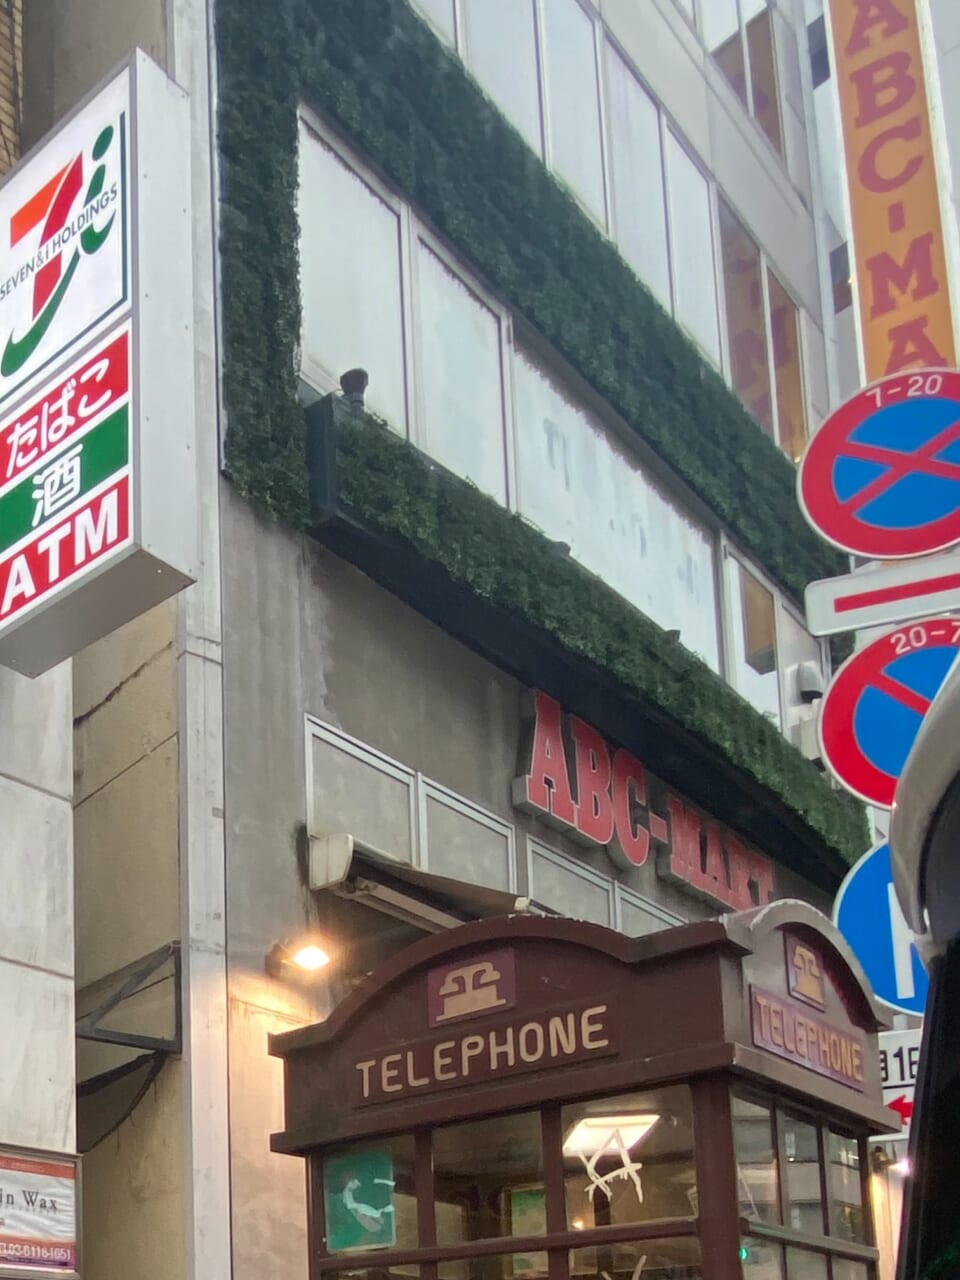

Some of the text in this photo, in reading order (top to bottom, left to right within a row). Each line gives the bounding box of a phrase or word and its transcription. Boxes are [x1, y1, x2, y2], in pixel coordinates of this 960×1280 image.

[52, 182, 118, 251] HOLDINGS
[6, 358, 113, 478] たばこ
[866, 374, 942, 408] 7-20
[31, 443, 83, 528] 酒
[0, 488, 119, 616] ATM
[526, 687, 776, 912] ABC-MART
[355, 1005, 609, 1098] TELEPHONE
[756, 993, 864, 1083] TELEPHONE
[22, 1190, 58, 1210] Wax
